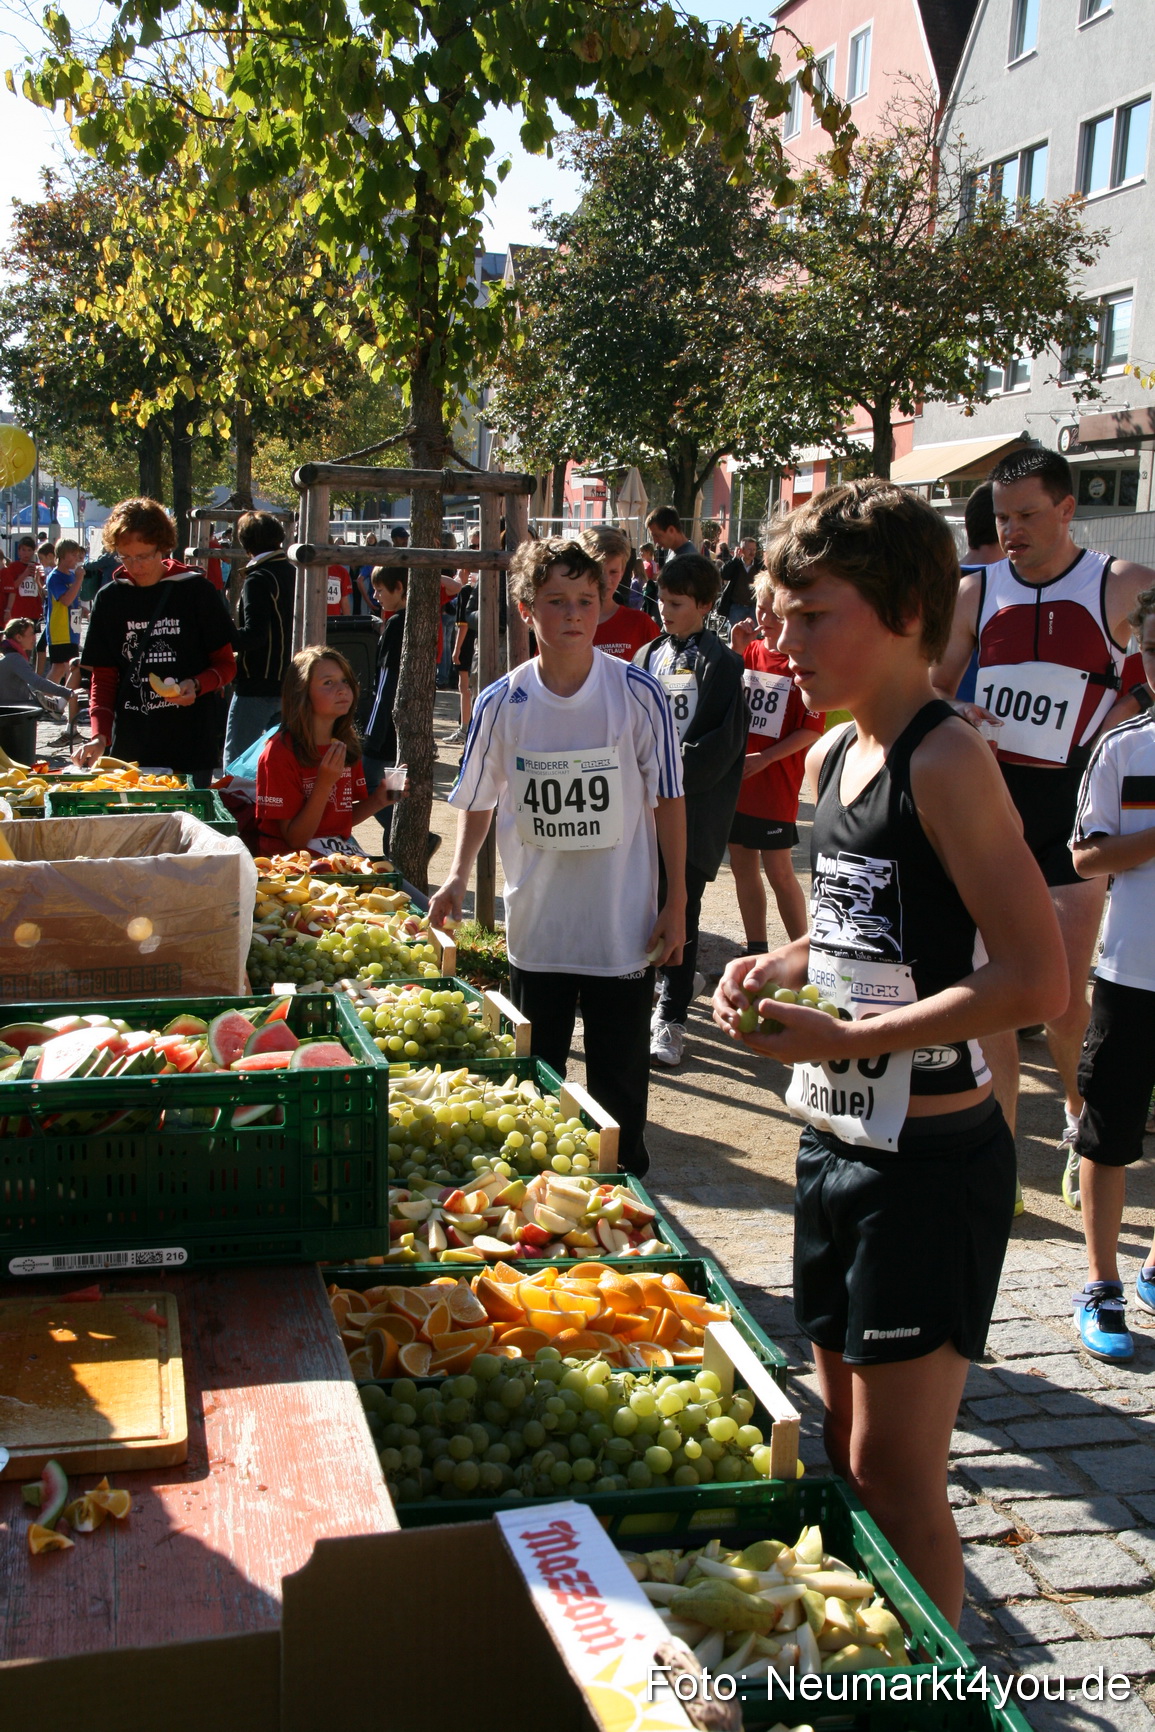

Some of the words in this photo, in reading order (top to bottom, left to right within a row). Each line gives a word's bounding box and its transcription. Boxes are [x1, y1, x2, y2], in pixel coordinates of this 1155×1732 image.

[982, 684, 1069, 730] 10091
[525, 759, 569, 770] PFLEIDERER
[581, 759, 610, 768] BOCK
[524, 775, 610, 815] 4049
[533, 817, 600, 838] Roman
[855, 950, 872, 961] bike
[850, 982, 900, 998] BOCK
[166, 1252, 184, 1261] 216
[862, 1326, 921, 1340] newline
